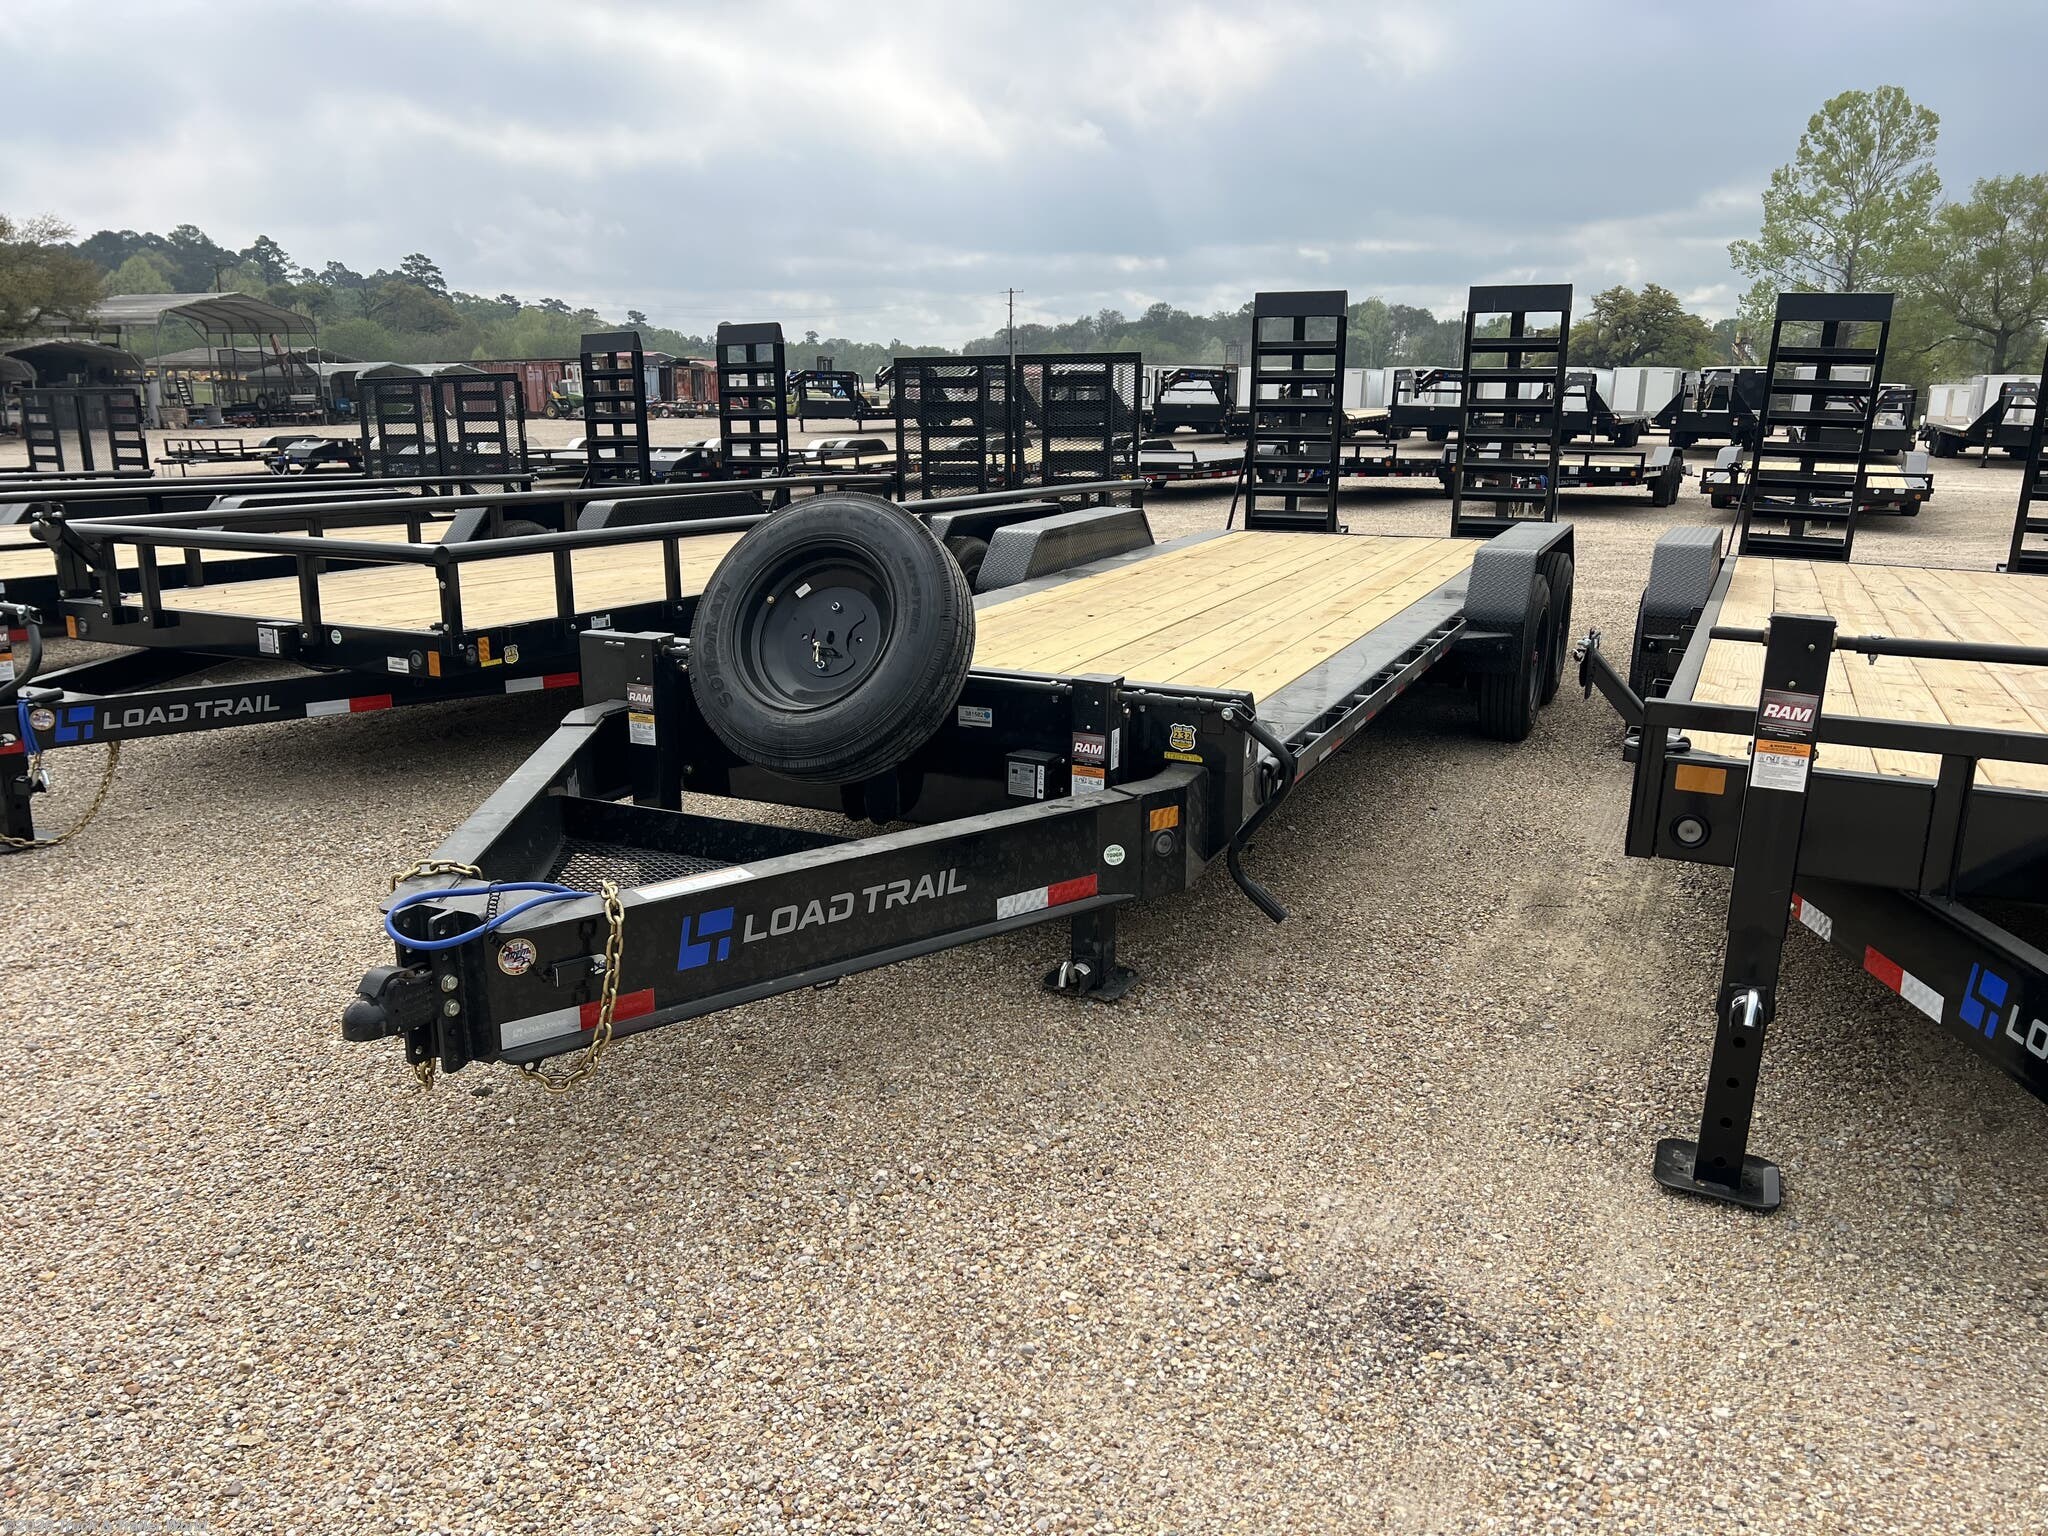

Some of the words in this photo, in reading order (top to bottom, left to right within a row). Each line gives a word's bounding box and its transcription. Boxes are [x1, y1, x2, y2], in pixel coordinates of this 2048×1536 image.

[629, 692, 651, 703] RAM
[103, 704, 189, 729] LOAD
[194, 694, 281, 719] TRAIL
[1763, 703, 1813, 722] RAM
[1074, 742, 1102, 755] RAM
[743, 892, 855, 943] LOAD
[862, 868, 967, 914] TRAIL
